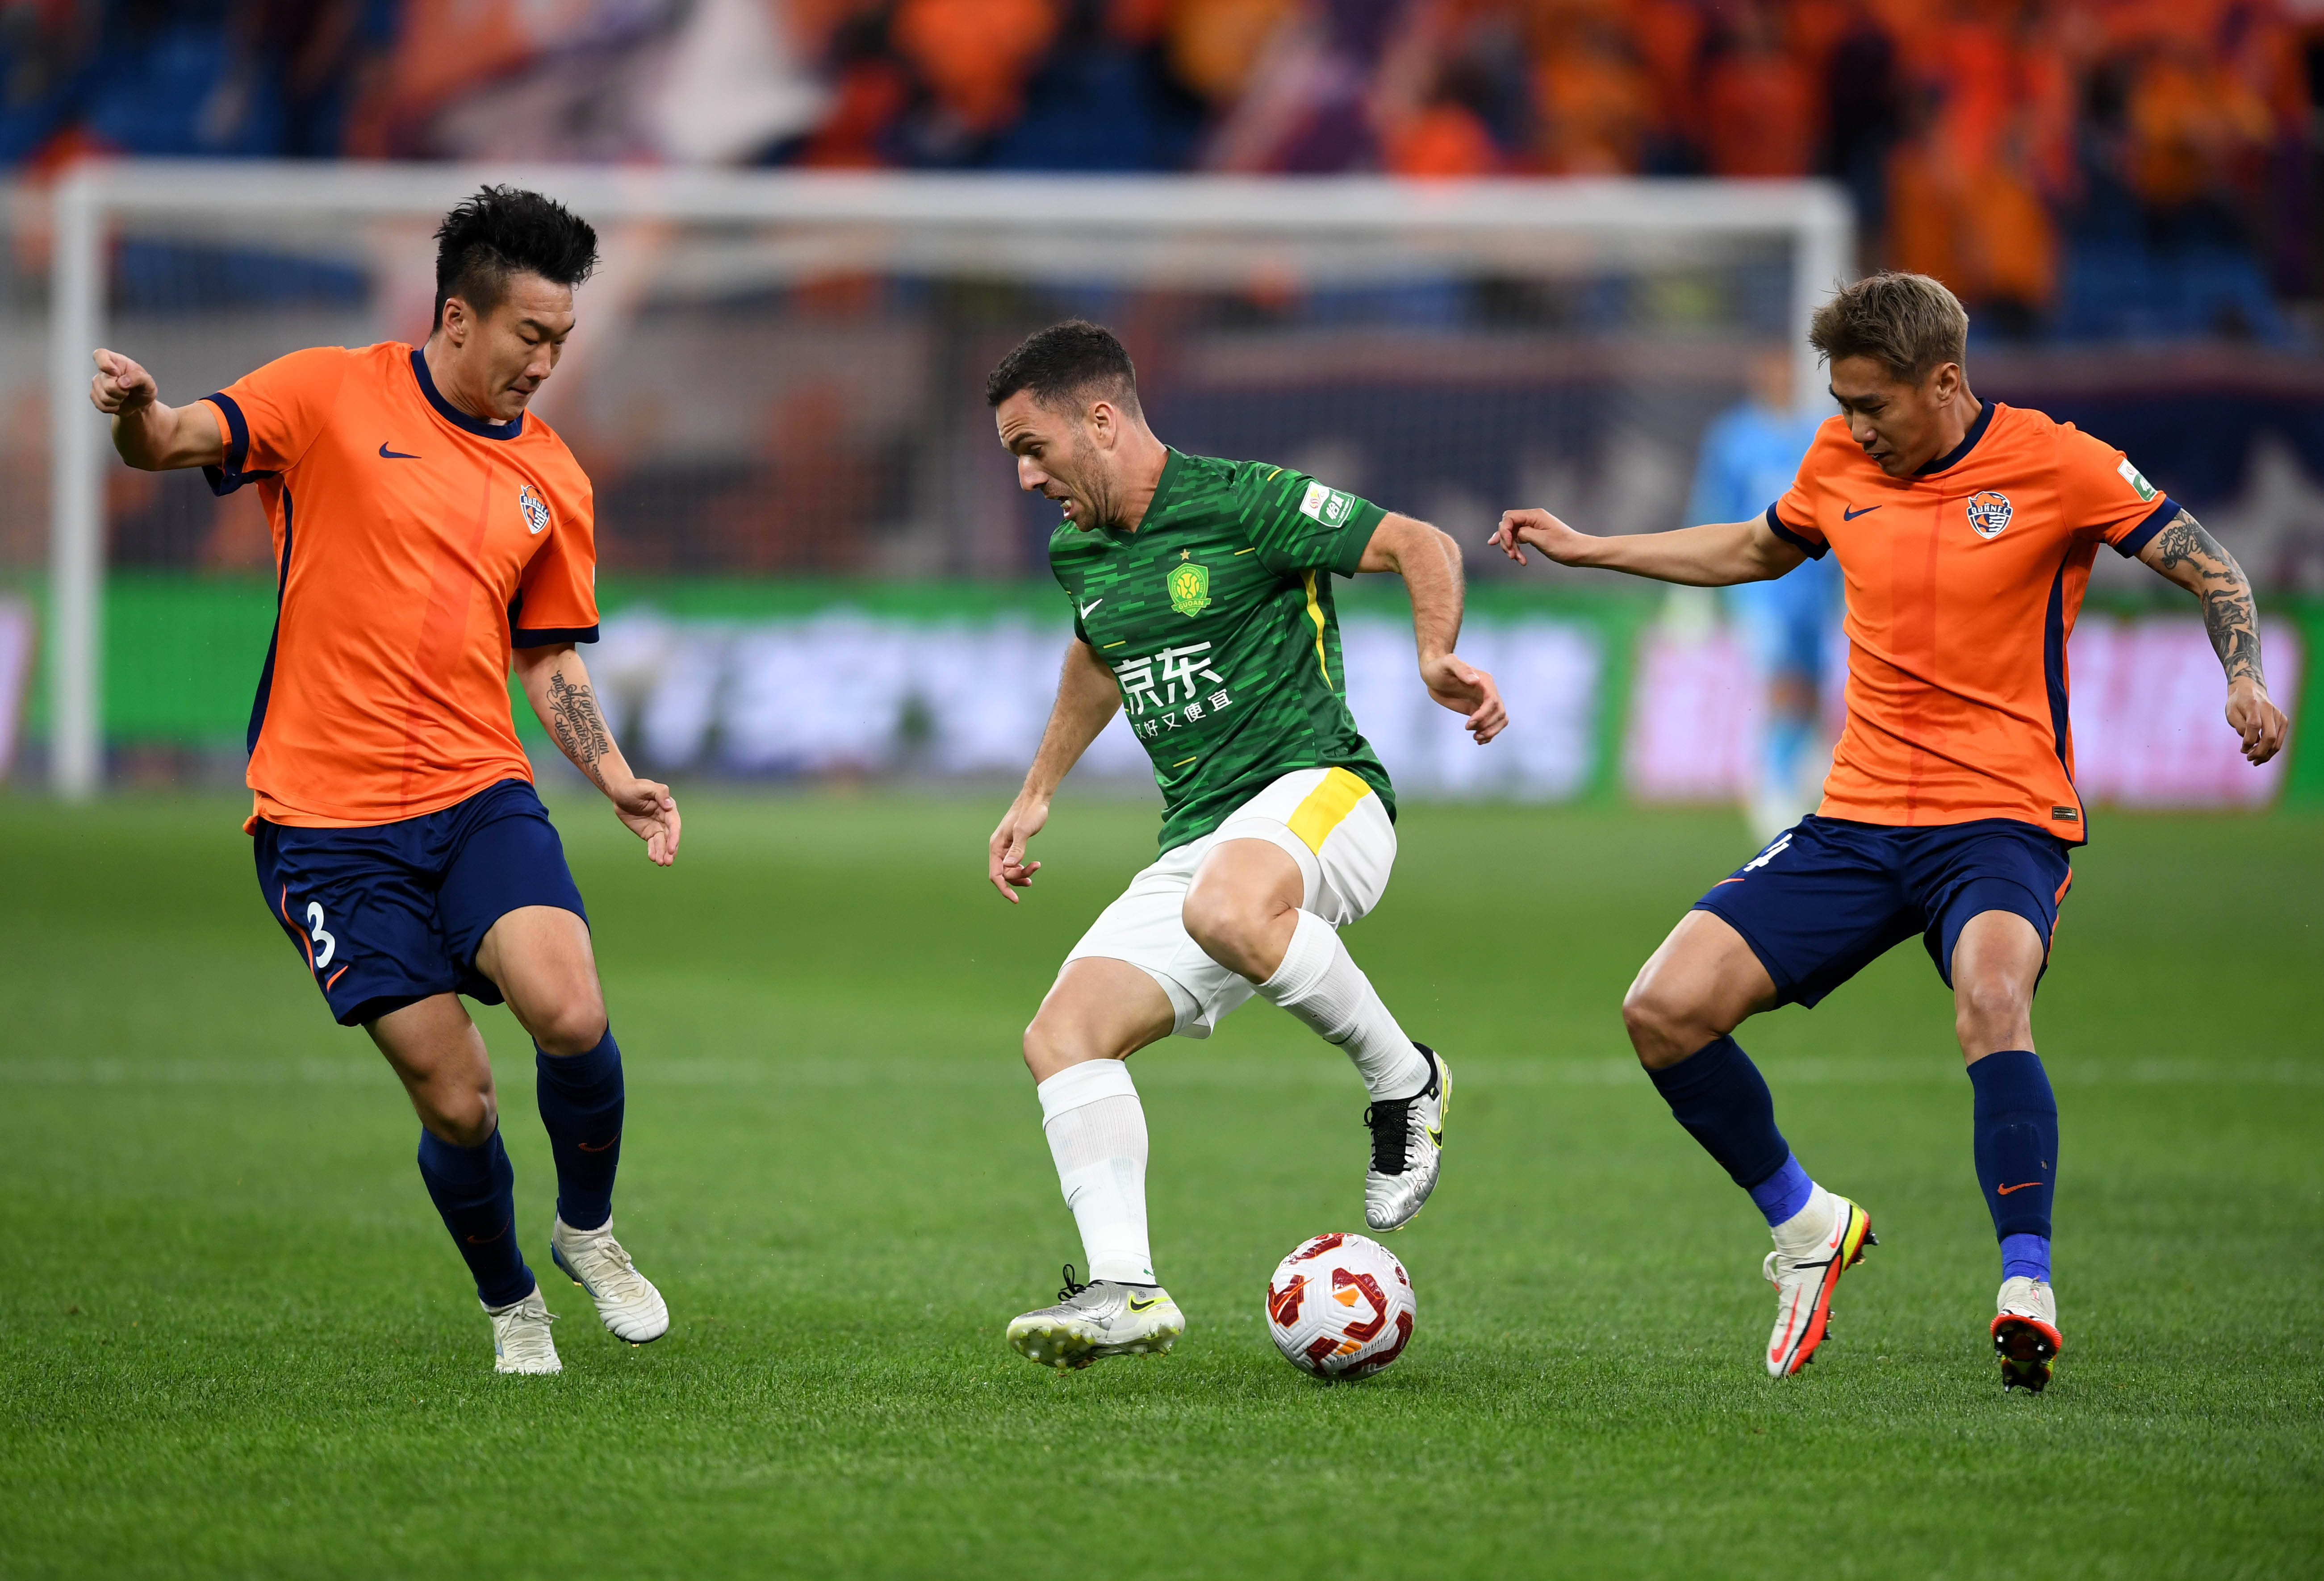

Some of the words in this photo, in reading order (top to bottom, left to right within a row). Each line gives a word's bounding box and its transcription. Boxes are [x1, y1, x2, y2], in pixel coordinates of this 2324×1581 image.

[1179, 600, 1204, 609] GUOAN
[1112, 641, 1224, 715] 京东
[1135, 688, 1233, 739] 又好又便宜
[582, 744, 595, 763] my
[594, 732, 610, 755] man
[307, 901, 335, 968] 3
